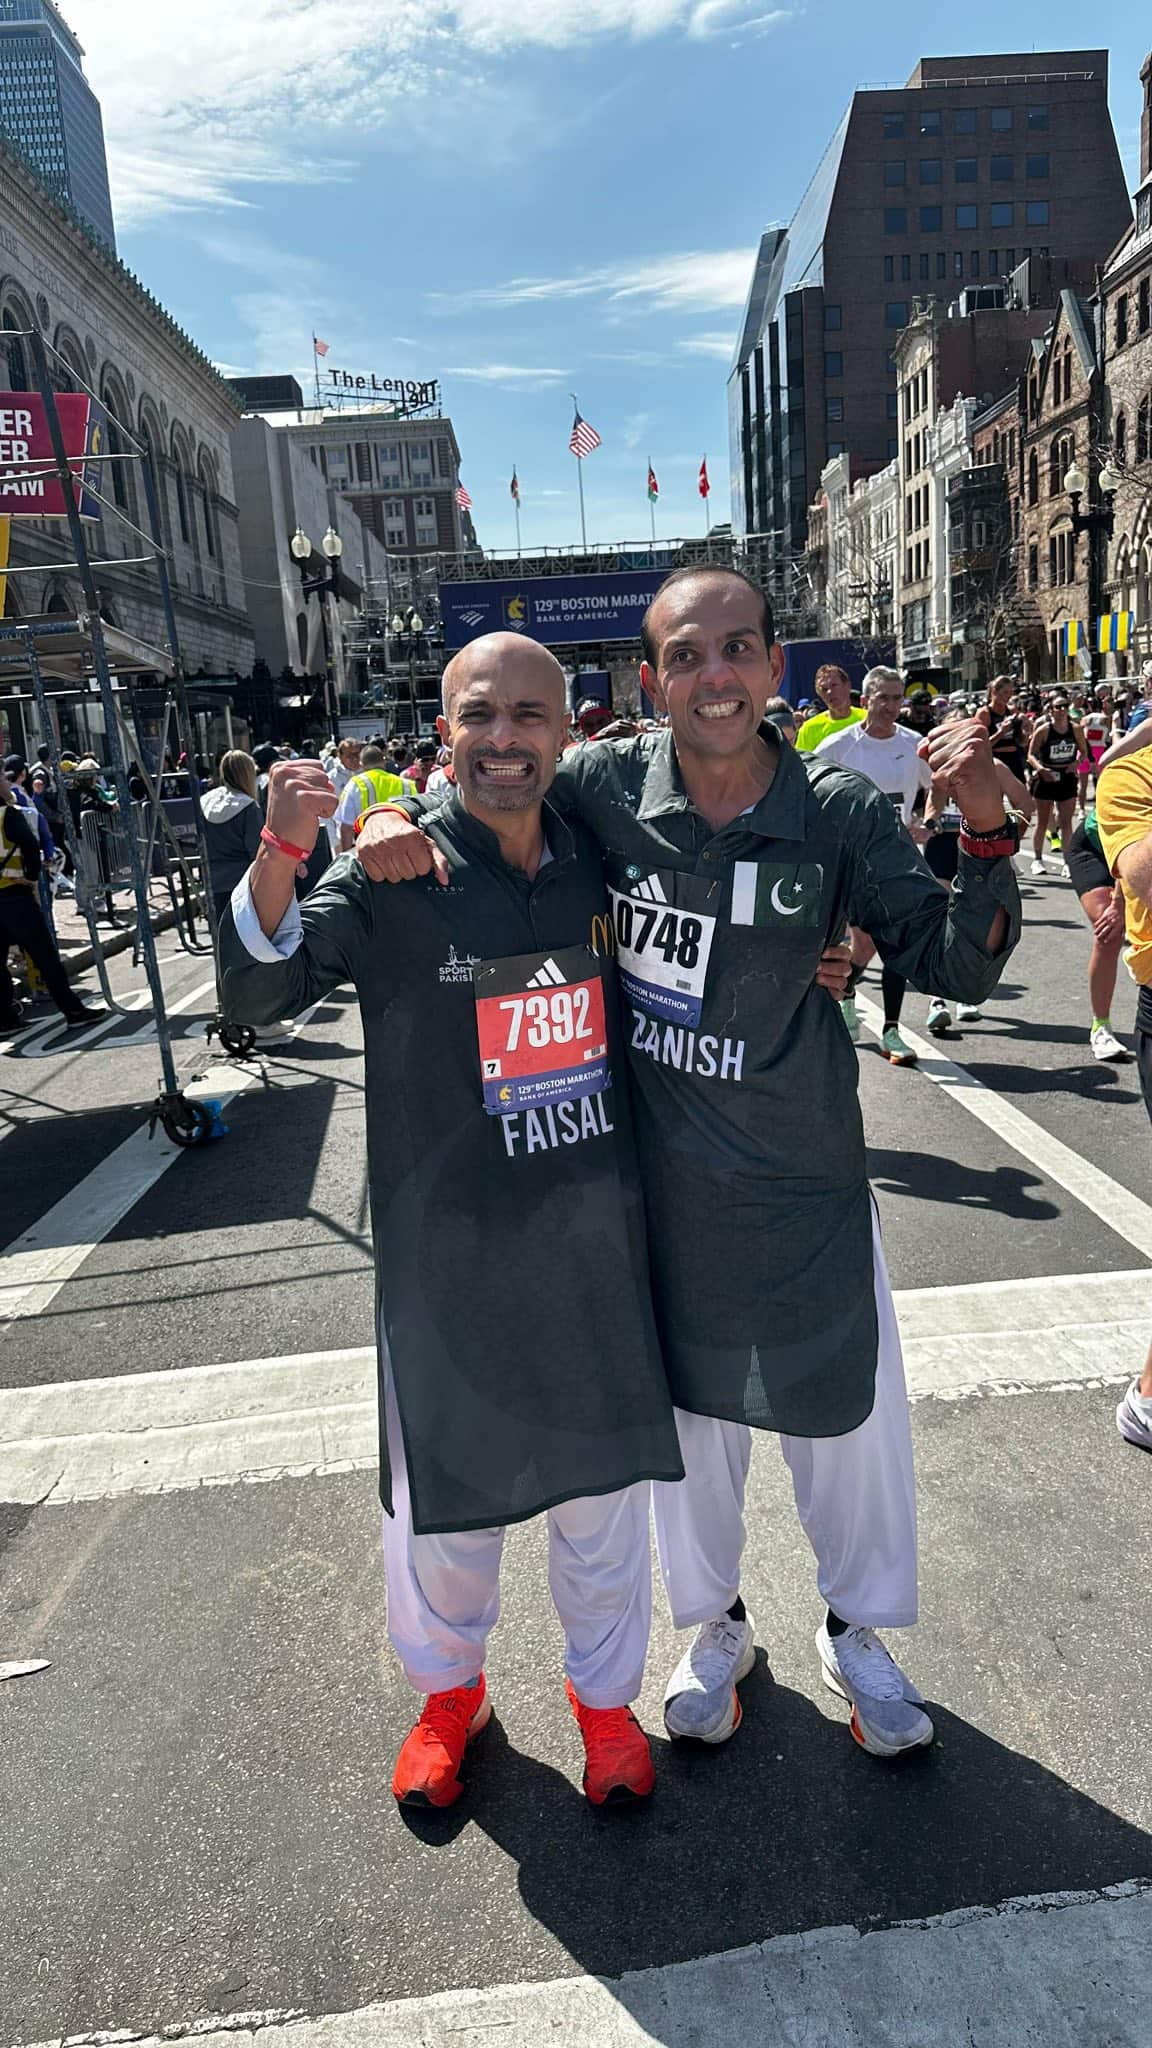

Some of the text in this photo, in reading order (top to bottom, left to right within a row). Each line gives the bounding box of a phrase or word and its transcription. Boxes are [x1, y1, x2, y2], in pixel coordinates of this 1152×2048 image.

[328, 368, 427, 394] The Lenox
[561, 597, 608, 611] BOSTON
[611, 593, 656, 608] MARAT
[537, 615, 561, 623] BANK
[577, 611, 619, 621] AMERICA
[608, 893, 702, 969] 0748
[649, 991, 688, 1011] MARATHON
[499, 987, 593, 1052] 7392
[487, 1063, 497, 1074] 7
[535, 1076, 566, 1092] BOSTON
[567, 1067, 603, 1084] MARATHON
[501, 1092, 614, 1157] FAISAL
